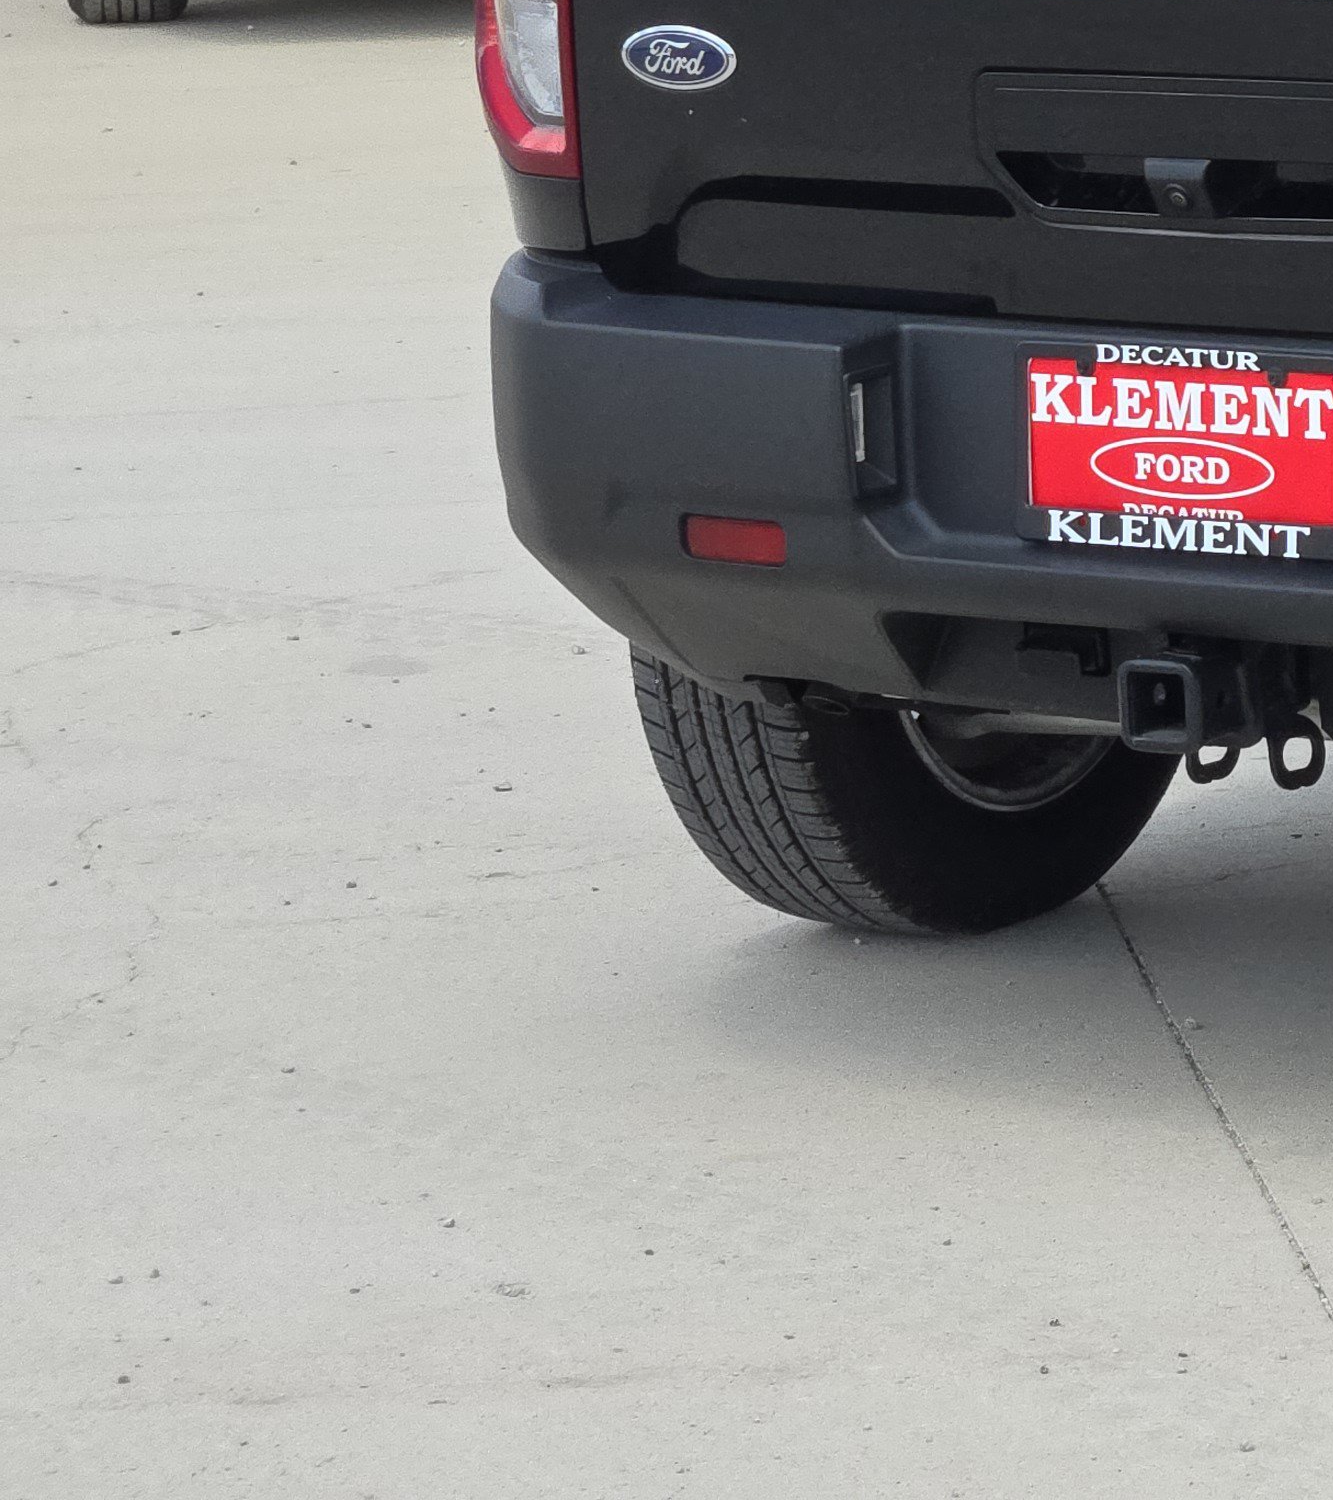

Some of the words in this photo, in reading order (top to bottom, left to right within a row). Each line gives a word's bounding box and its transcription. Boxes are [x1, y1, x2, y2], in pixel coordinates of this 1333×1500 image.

[644, 38, 706, 76] Ford
[1095, 343, 1262, 373] DECATUR
[1134, 451, 1231, 485] FORD
[1047, 508, 1311, 560] KLEMENT
